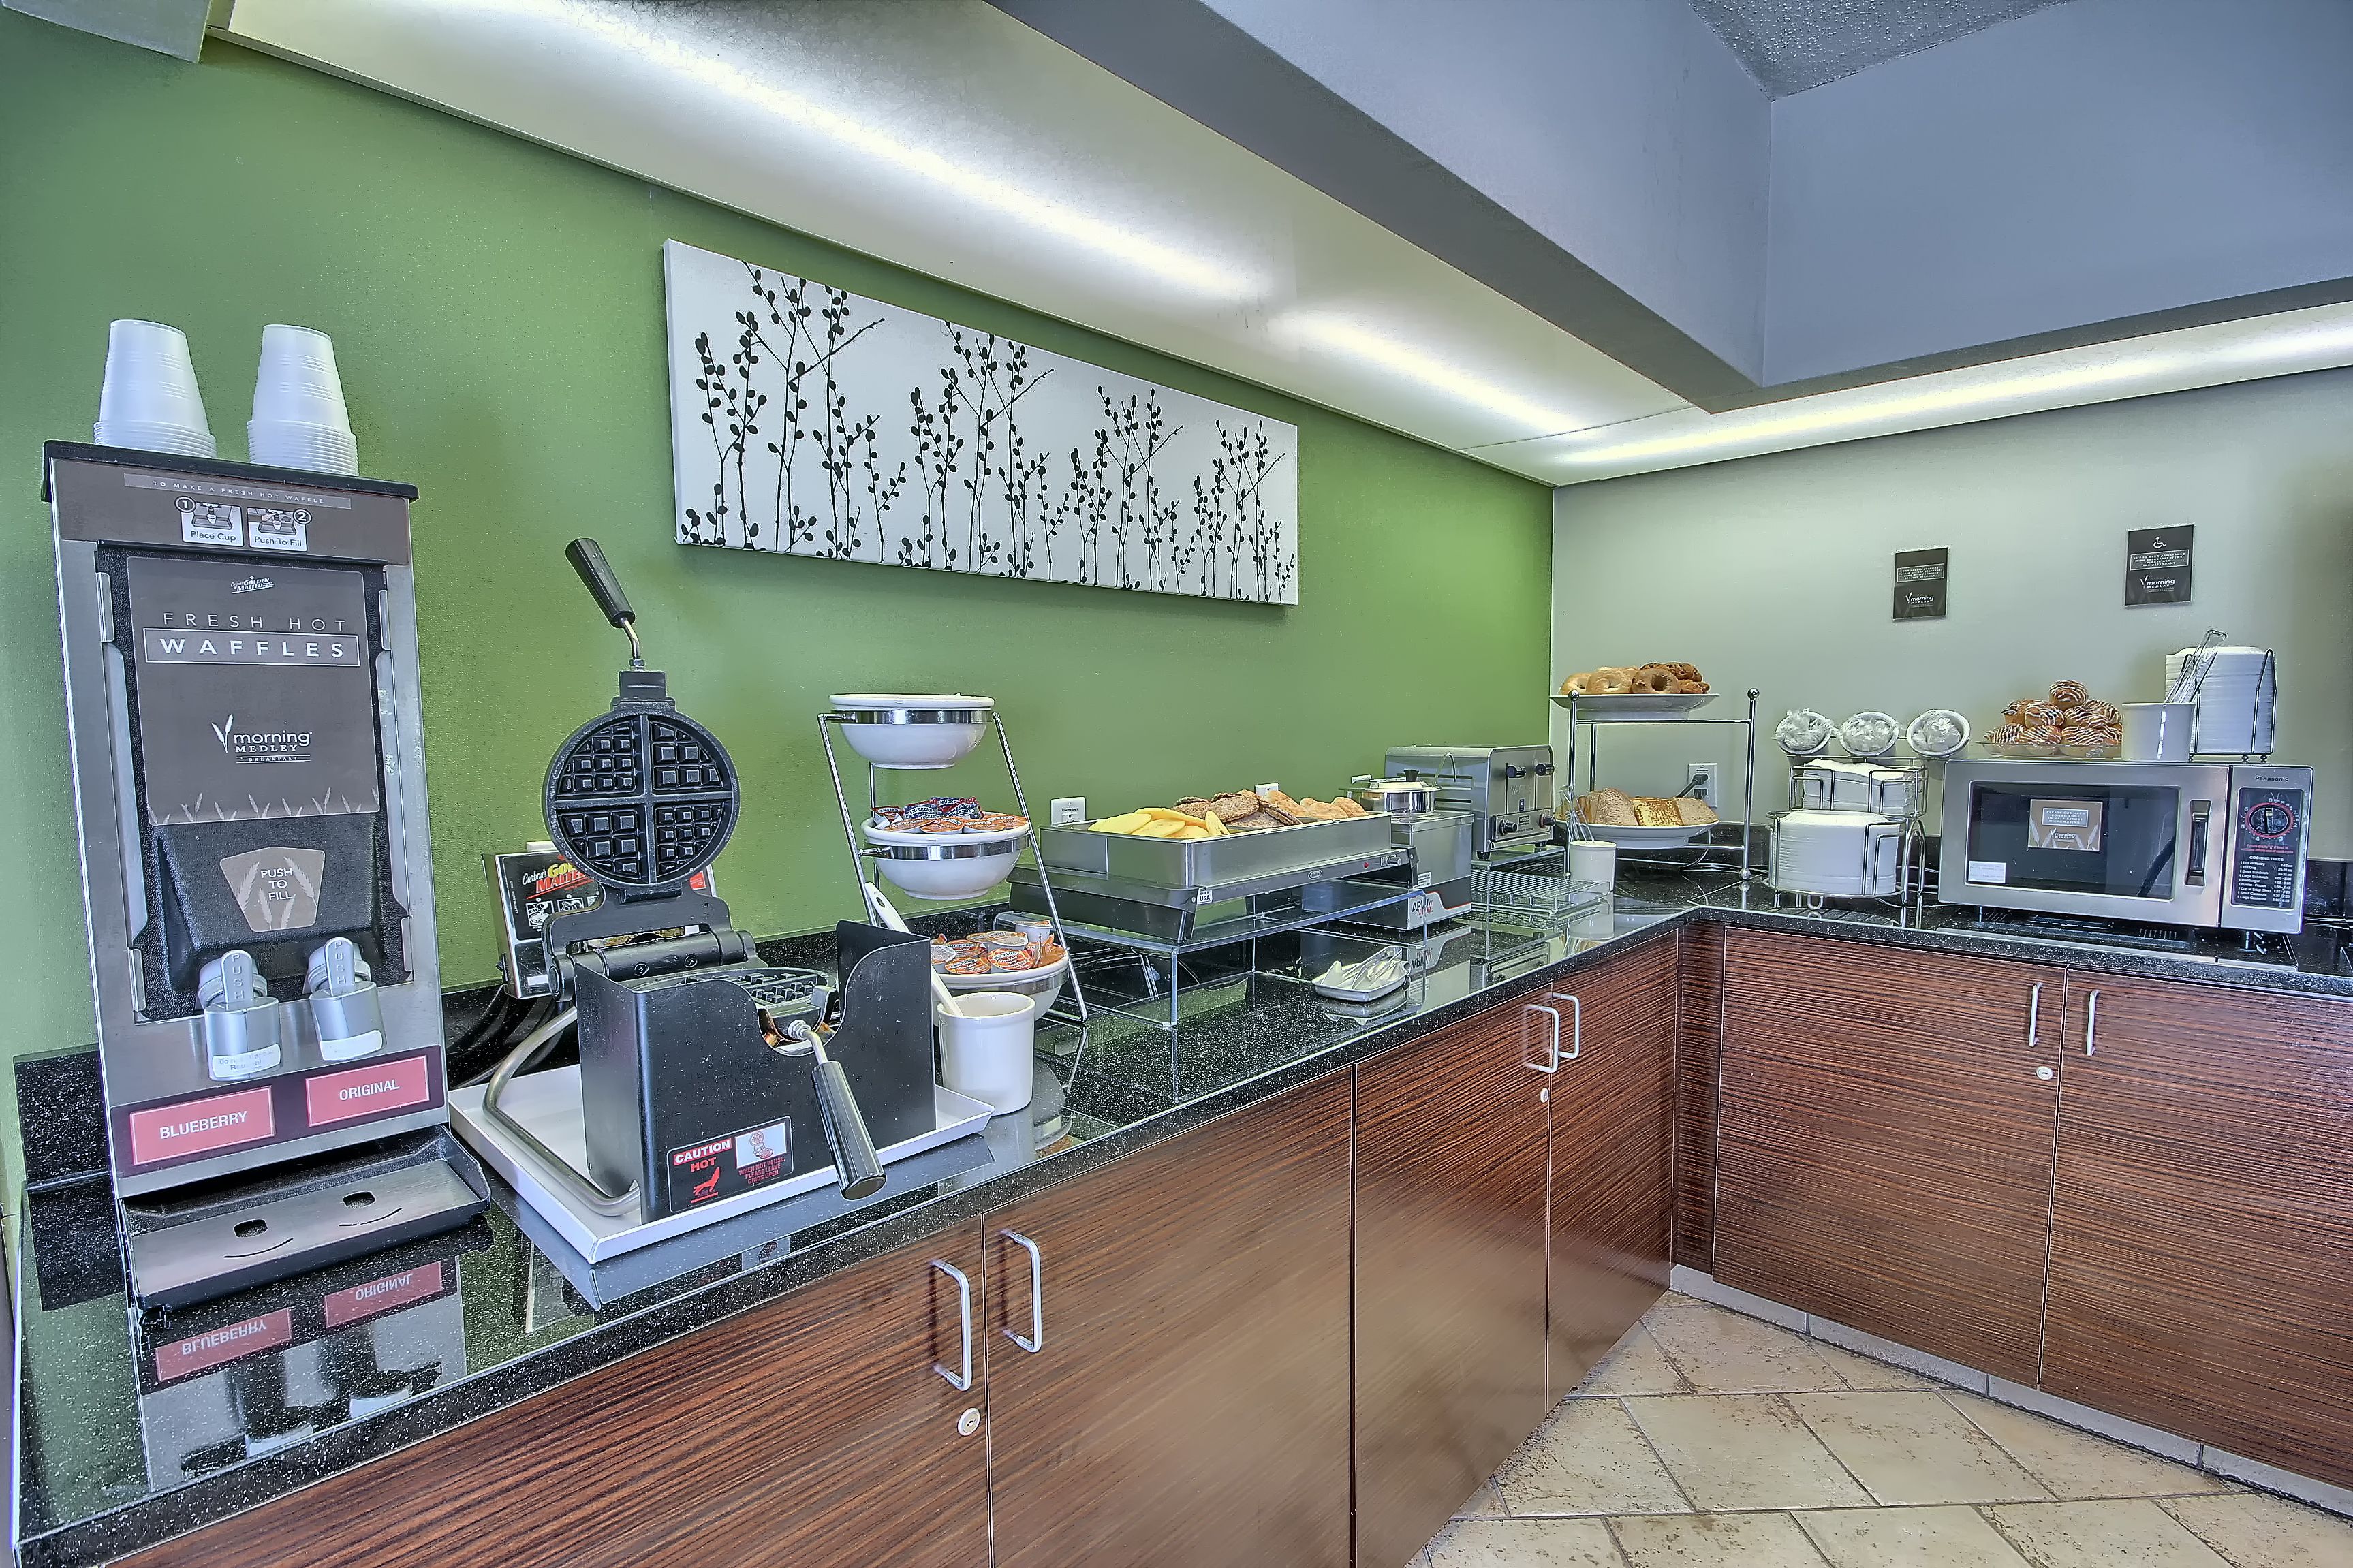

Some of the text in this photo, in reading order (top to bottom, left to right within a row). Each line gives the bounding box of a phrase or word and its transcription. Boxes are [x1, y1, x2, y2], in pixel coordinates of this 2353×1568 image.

[174, 482, 202, 491] MAKE
[221, 488, 253, 497] FRESH
[285, 495, 324, 504] WAFFLE
[191, 531, 236, 543] Place Cup
[254, 536, 275, 545] Push
[290, 539, 302, 547] Fill
[163, 613, 345, 631] FRESH HOT
[160, 638, 343, 657] WAFFLES
[234, 730, 310, 747] morning
[235, 744, 298, 753] MEDLEY
[260, 868, 293, 879] PUSH
[522, 868, 548, 885] Carbon's
[268, 879, 287, 890] TO
[268, 891, 293, 901] FILL
[339, 1079, 400, 1101] ORIGINAL
[159, 1110, 248, 1140] BLUEBERRY
[674, 1140, 730, 1163] CAUTION
[691, 1157, 716, 1172] HOT
[739, 1165, 755, 1176] WHEN
[755, 1162, 766, 1171] NOT
[745, 1163, 781, 1180] PLEASE LEAVE
[747, 1170, 779, 1185] GRIDS OPEN
